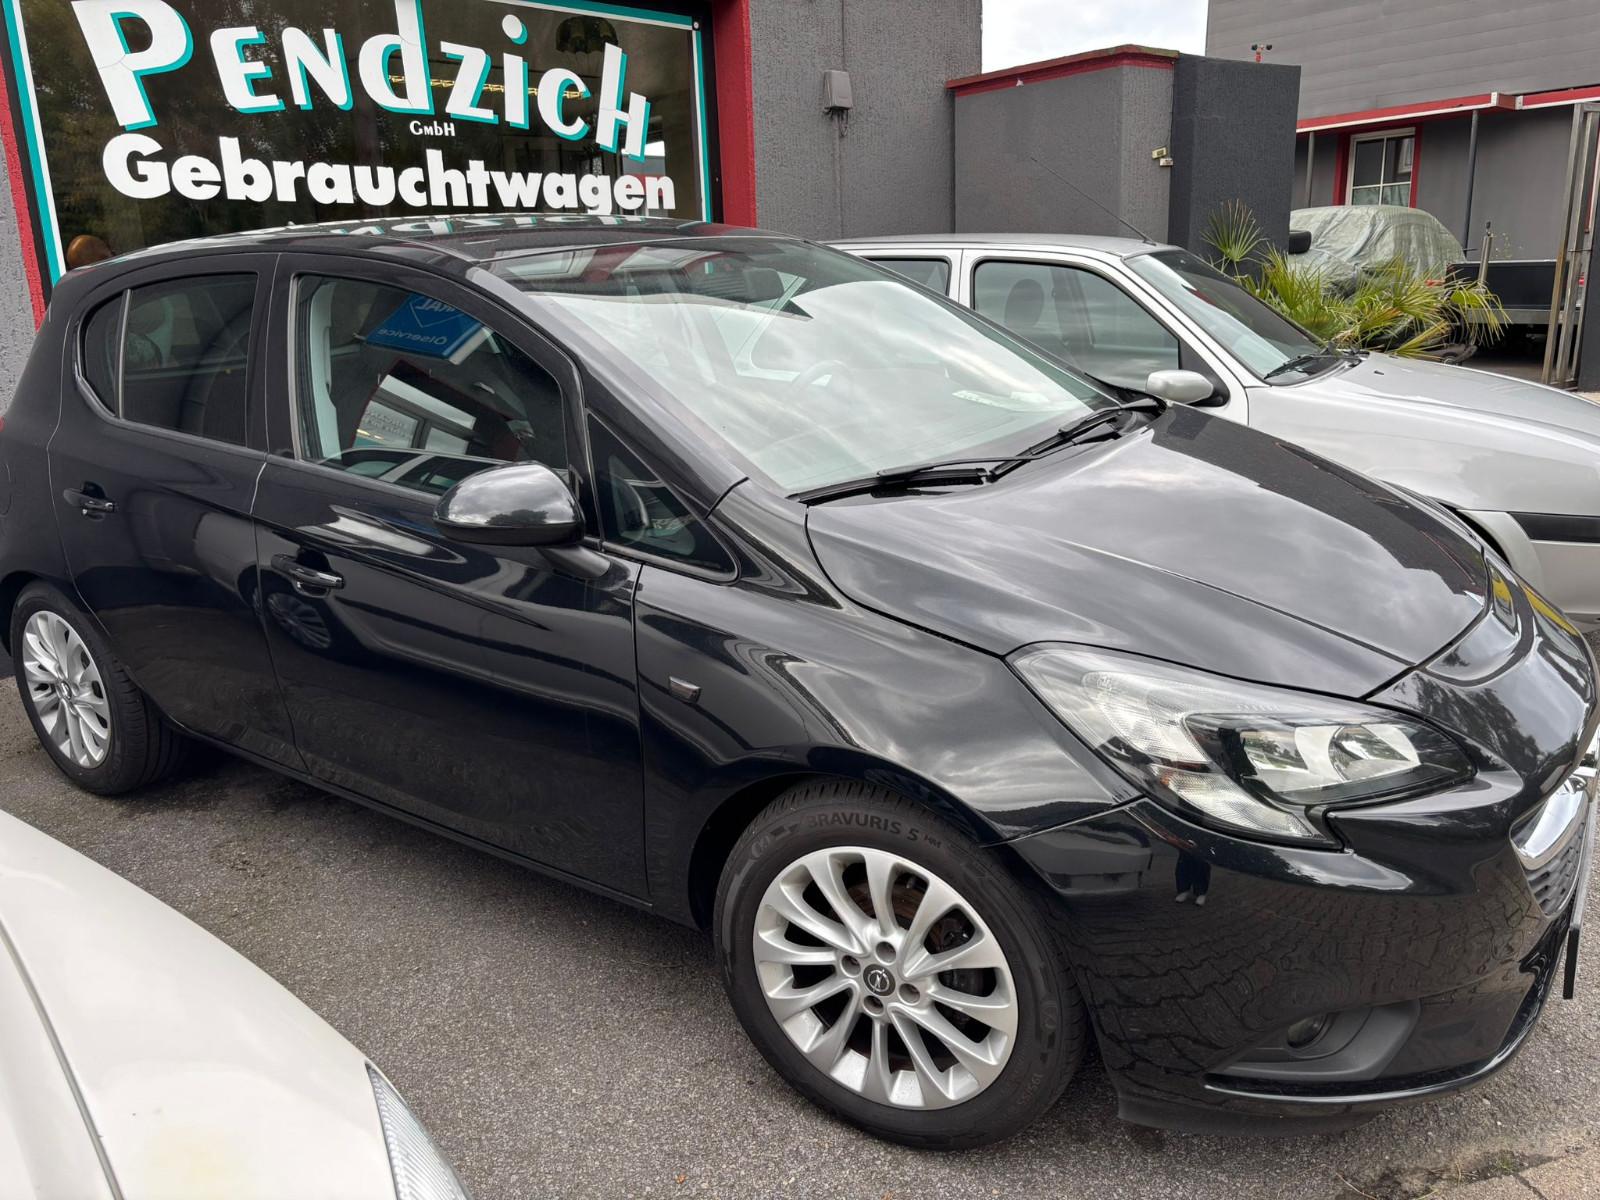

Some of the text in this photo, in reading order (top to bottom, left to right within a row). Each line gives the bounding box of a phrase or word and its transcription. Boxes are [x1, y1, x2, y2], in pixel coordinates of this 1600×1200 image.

[102, 133, 676, 216] Gebrauchtwagen
[807, 812, 901, 835] BRAVURIS
[906, 827, 920, 842] 5
